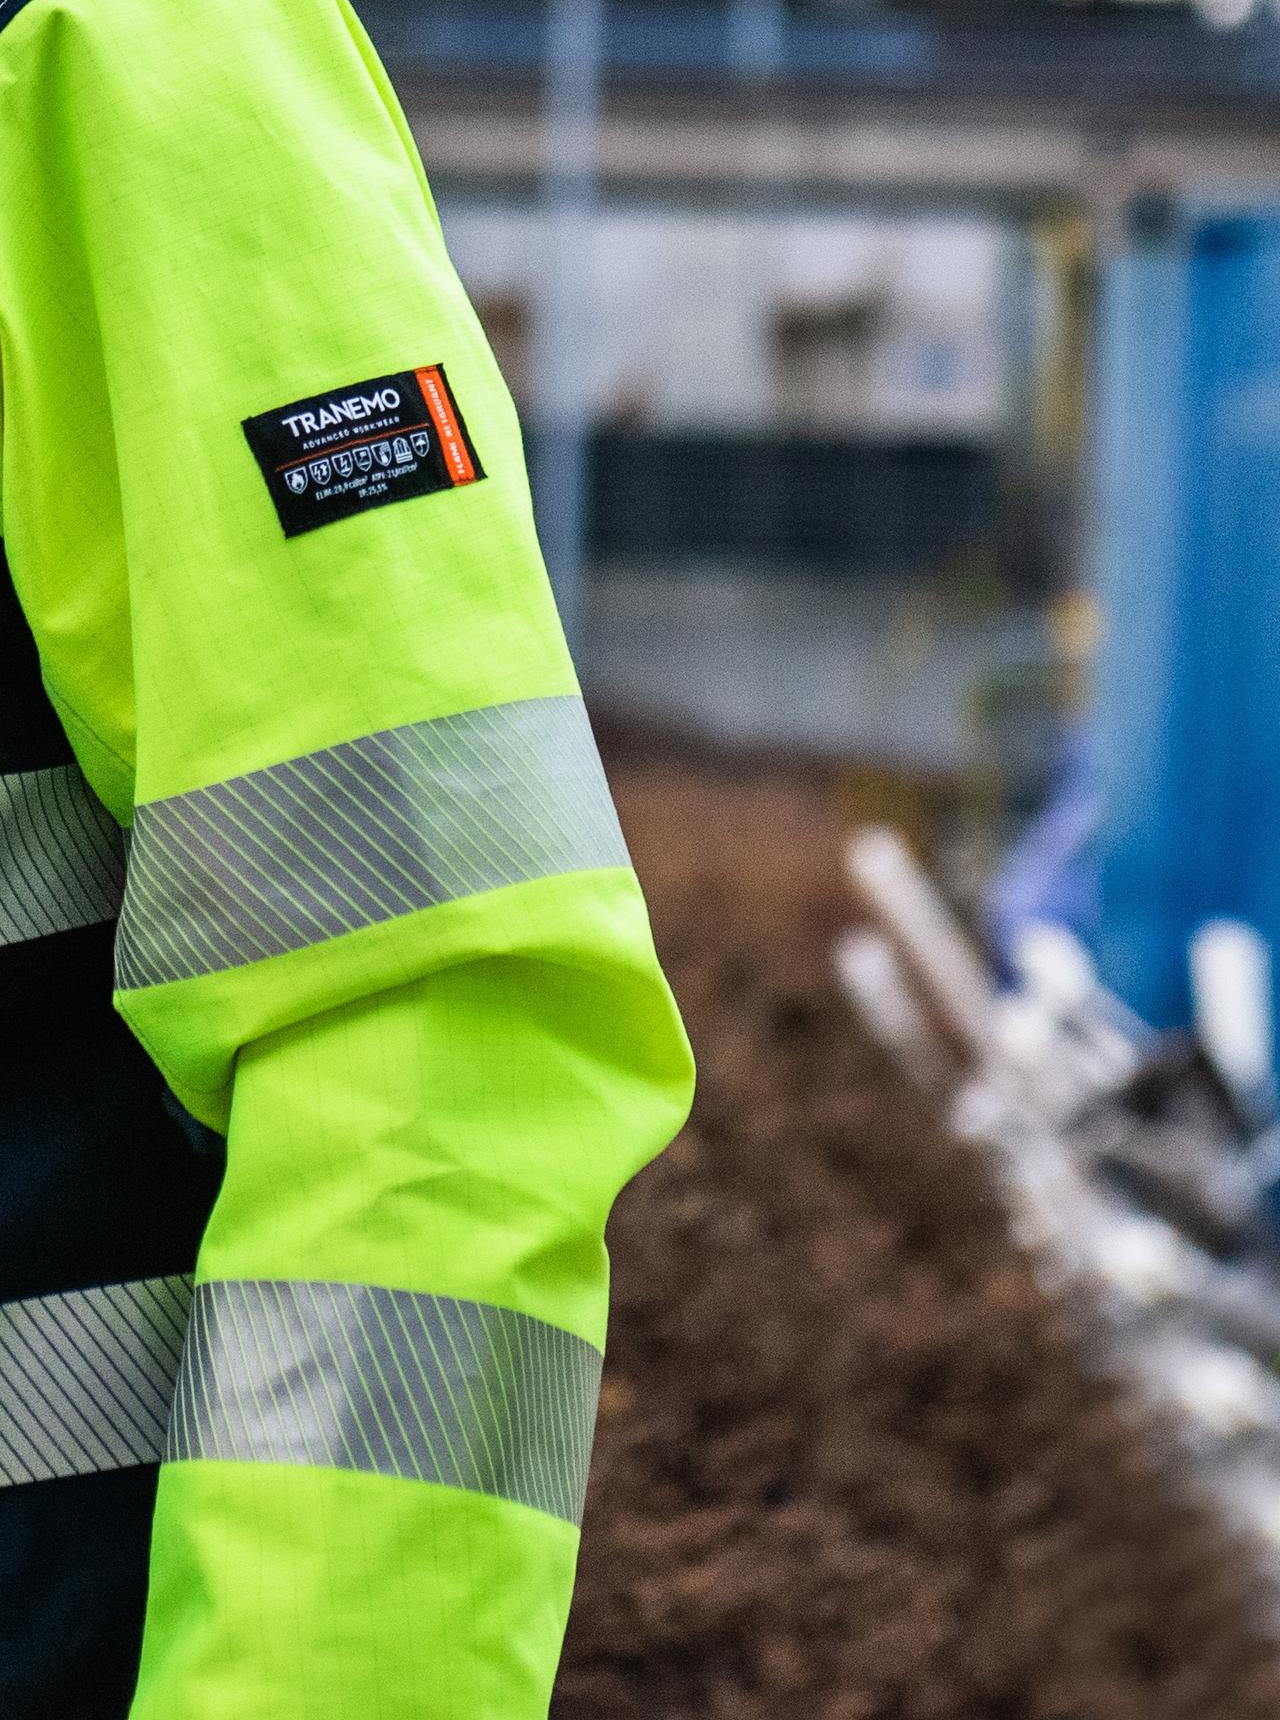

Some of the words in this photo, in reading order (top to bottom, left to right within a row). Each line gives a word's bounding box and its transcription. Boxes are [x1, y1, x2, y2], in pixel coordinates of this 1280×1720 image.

[282, 388, 400, 438] TRANEMO
[303, 429, 350, 450] ADVANCED
[353, 416, 400, 434] WORKWEAR
